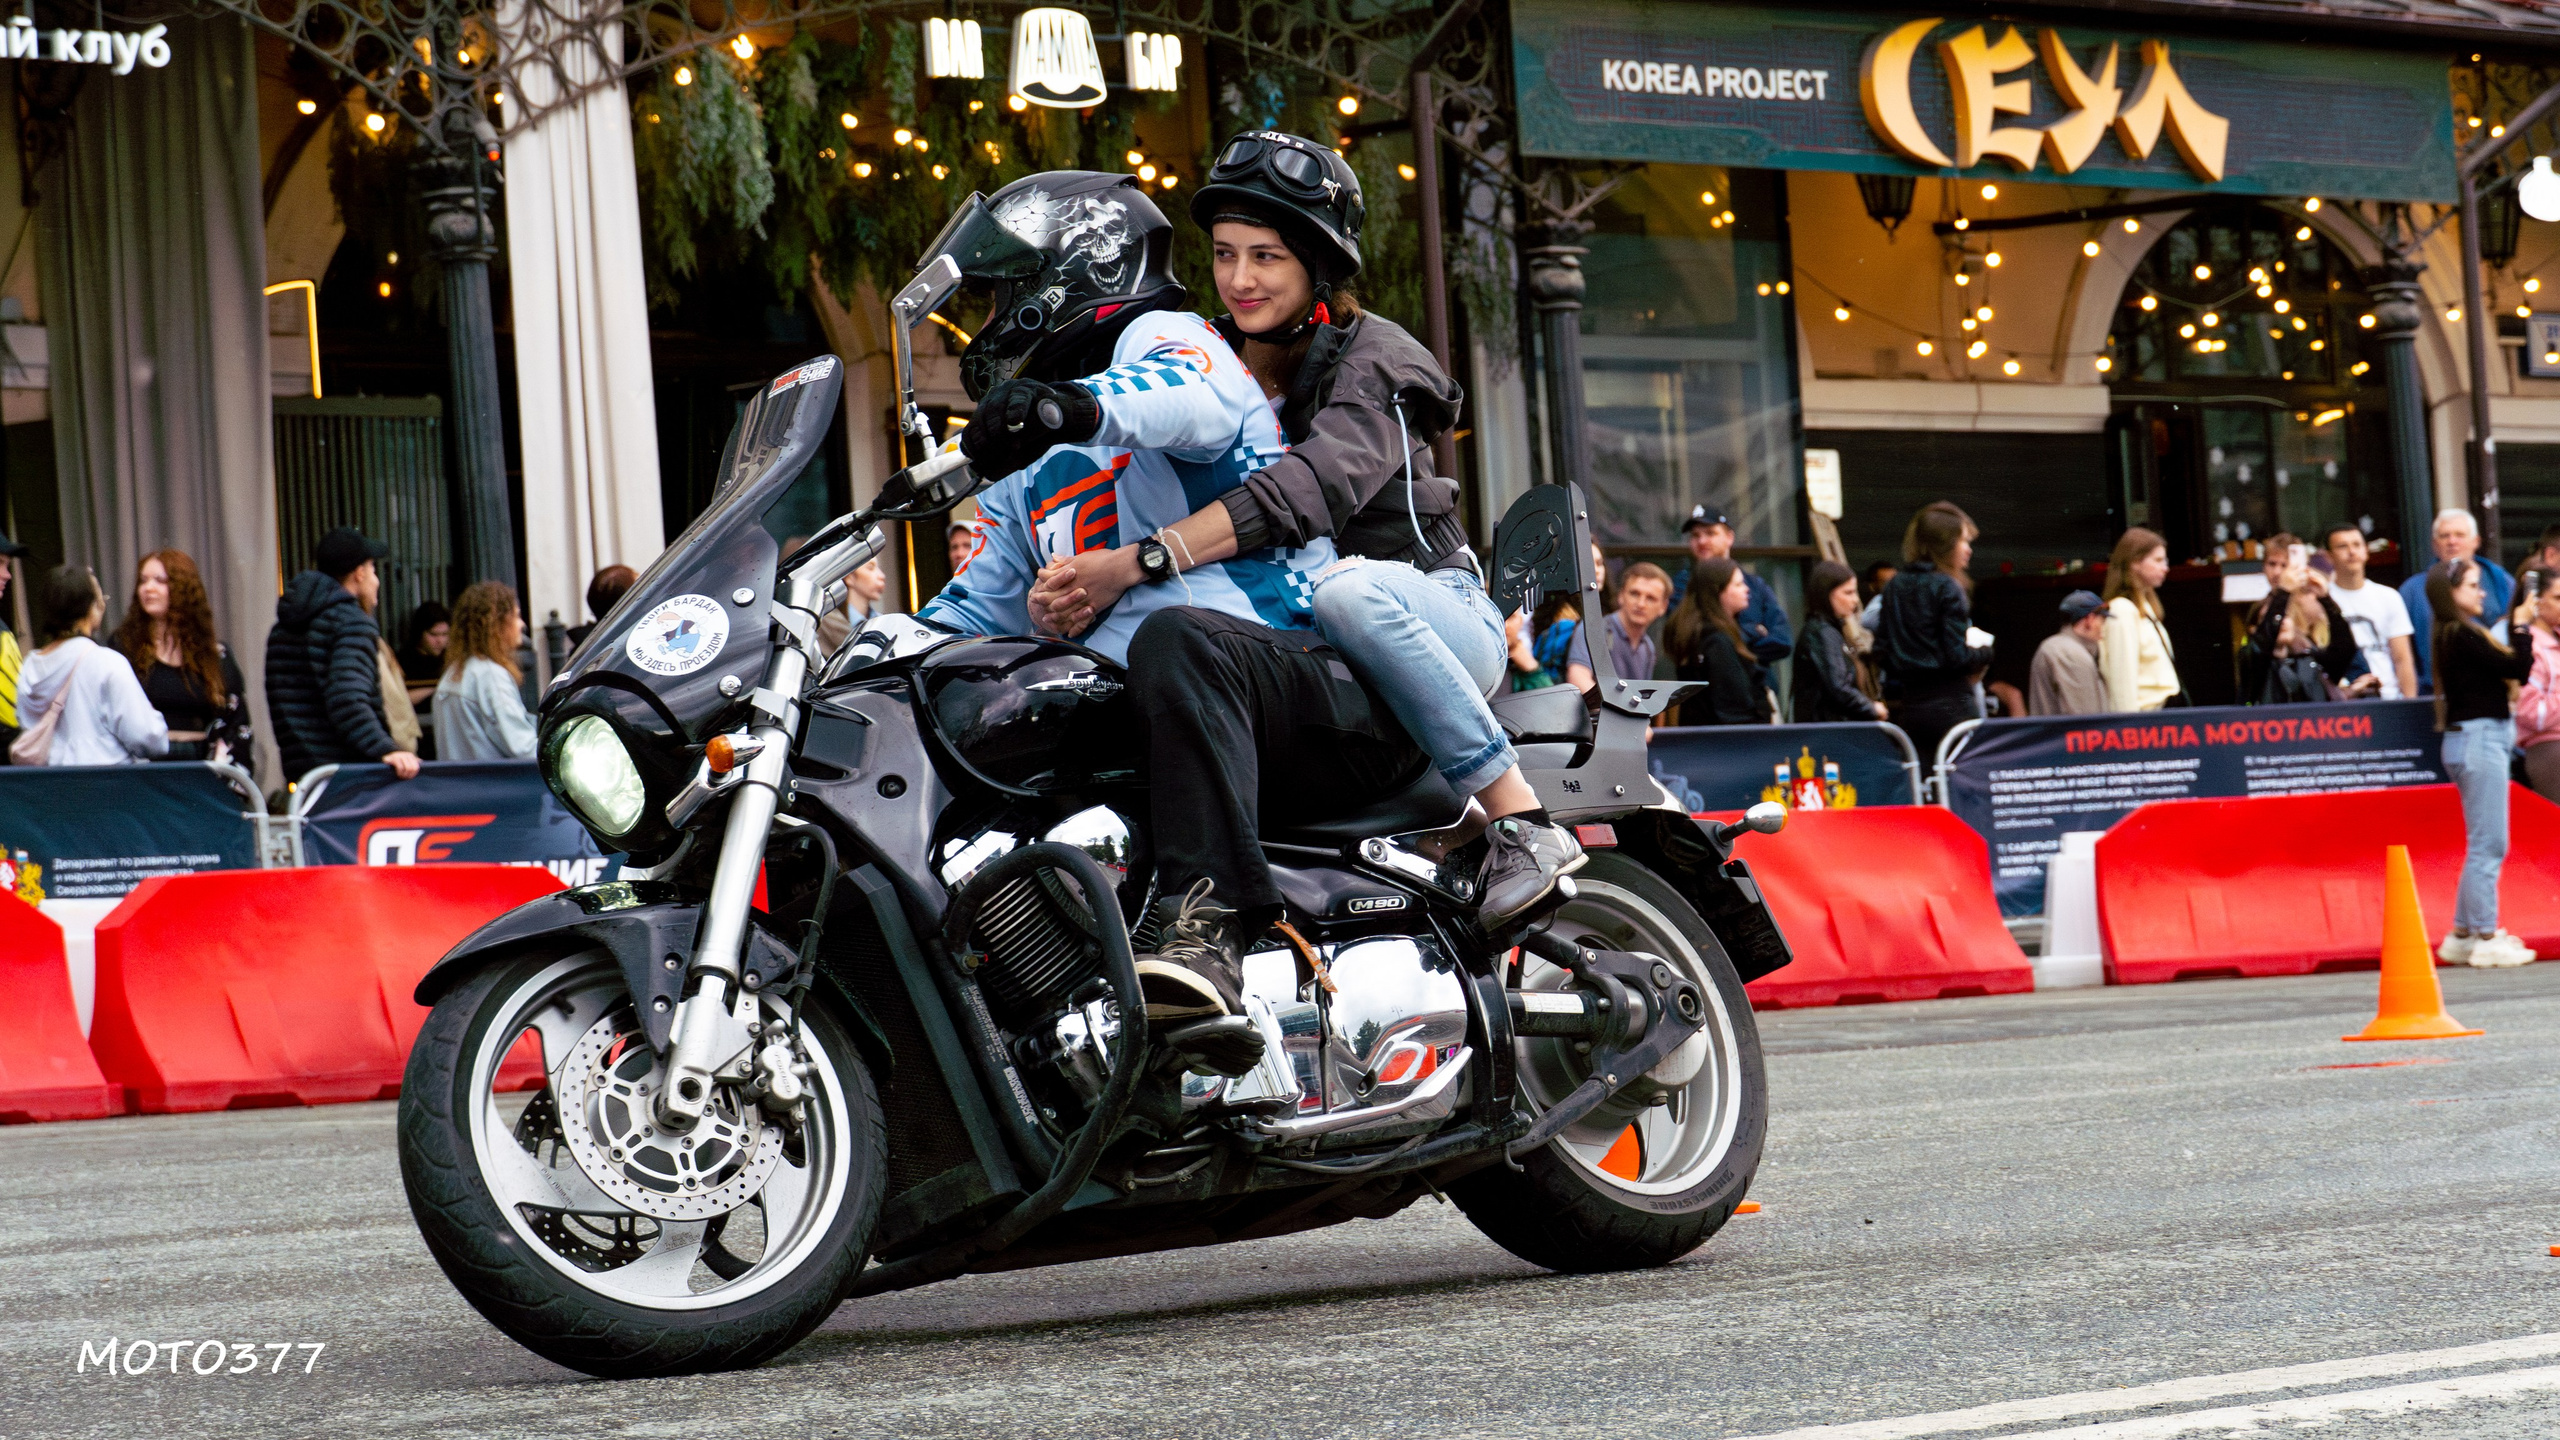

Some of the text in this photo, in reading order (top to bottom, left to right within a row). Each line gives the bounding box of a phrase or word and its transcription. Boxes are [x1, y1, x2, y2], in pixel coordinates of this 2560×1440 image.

[52, 22, 171, 76] клуб
[1127, 32, 1182, 91] БАР
[1602, 58, 1829, 100] KOREA PROJECT
[1860, 17, 2229, 182] СЕУЛ
[637, 596, 719, 631] ТВОРИ БАРДАК
[632, 632, 724, 672] МЫ ЗДЕСЬ ПРОЕЗДОМ
[2065, 716, 2373, 753] ПРАВИЛА МОТОТАКСИ
[54, 854, 221, 870] Департамент по развитию туризма
[64, 871, 116, 885] индустрии
[55, 882, 128, 897] Свердловской
[1354, 898, 1400, 911] M90
